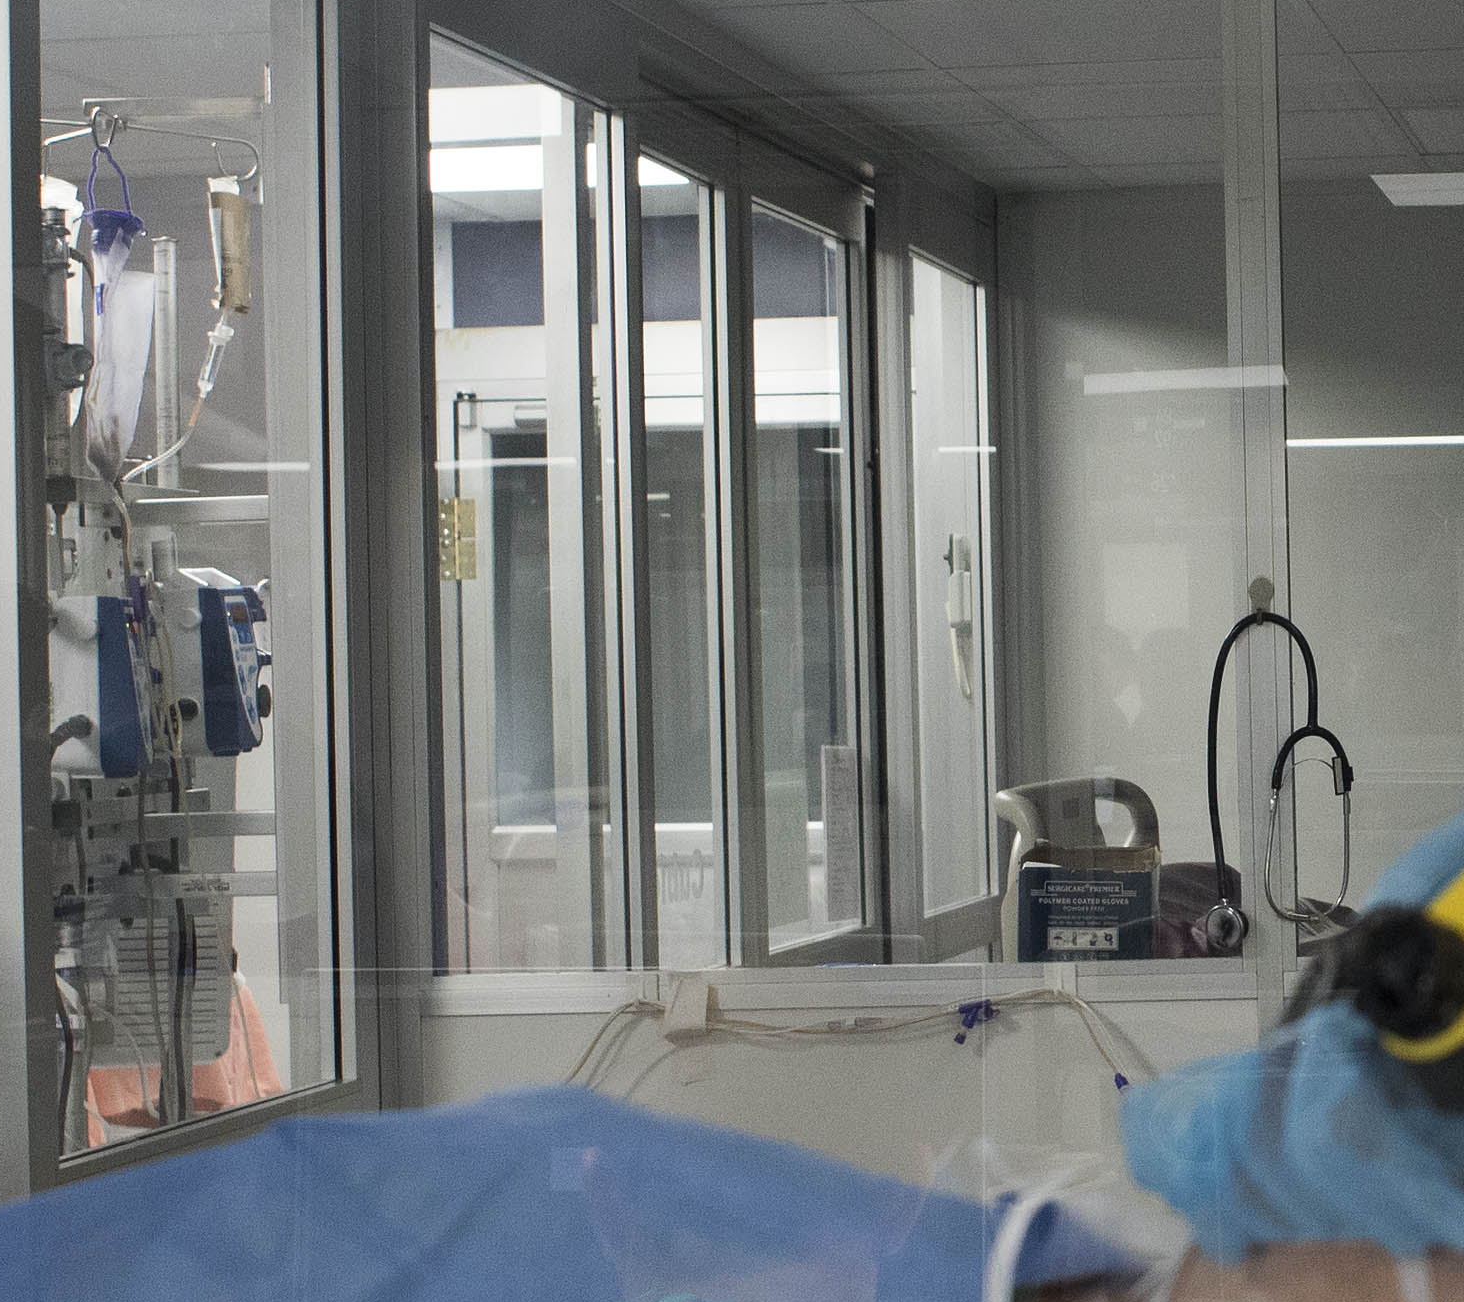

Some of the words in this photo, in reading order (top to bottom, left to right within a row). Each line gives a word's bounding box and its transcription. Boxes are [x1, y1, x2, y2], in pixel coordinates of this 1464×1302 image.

[1038, 897, 1071, 905] POLYMER
[1072, 897, 1100, 905] COATED
[1101, 897, 1129, 905] GLOVES
